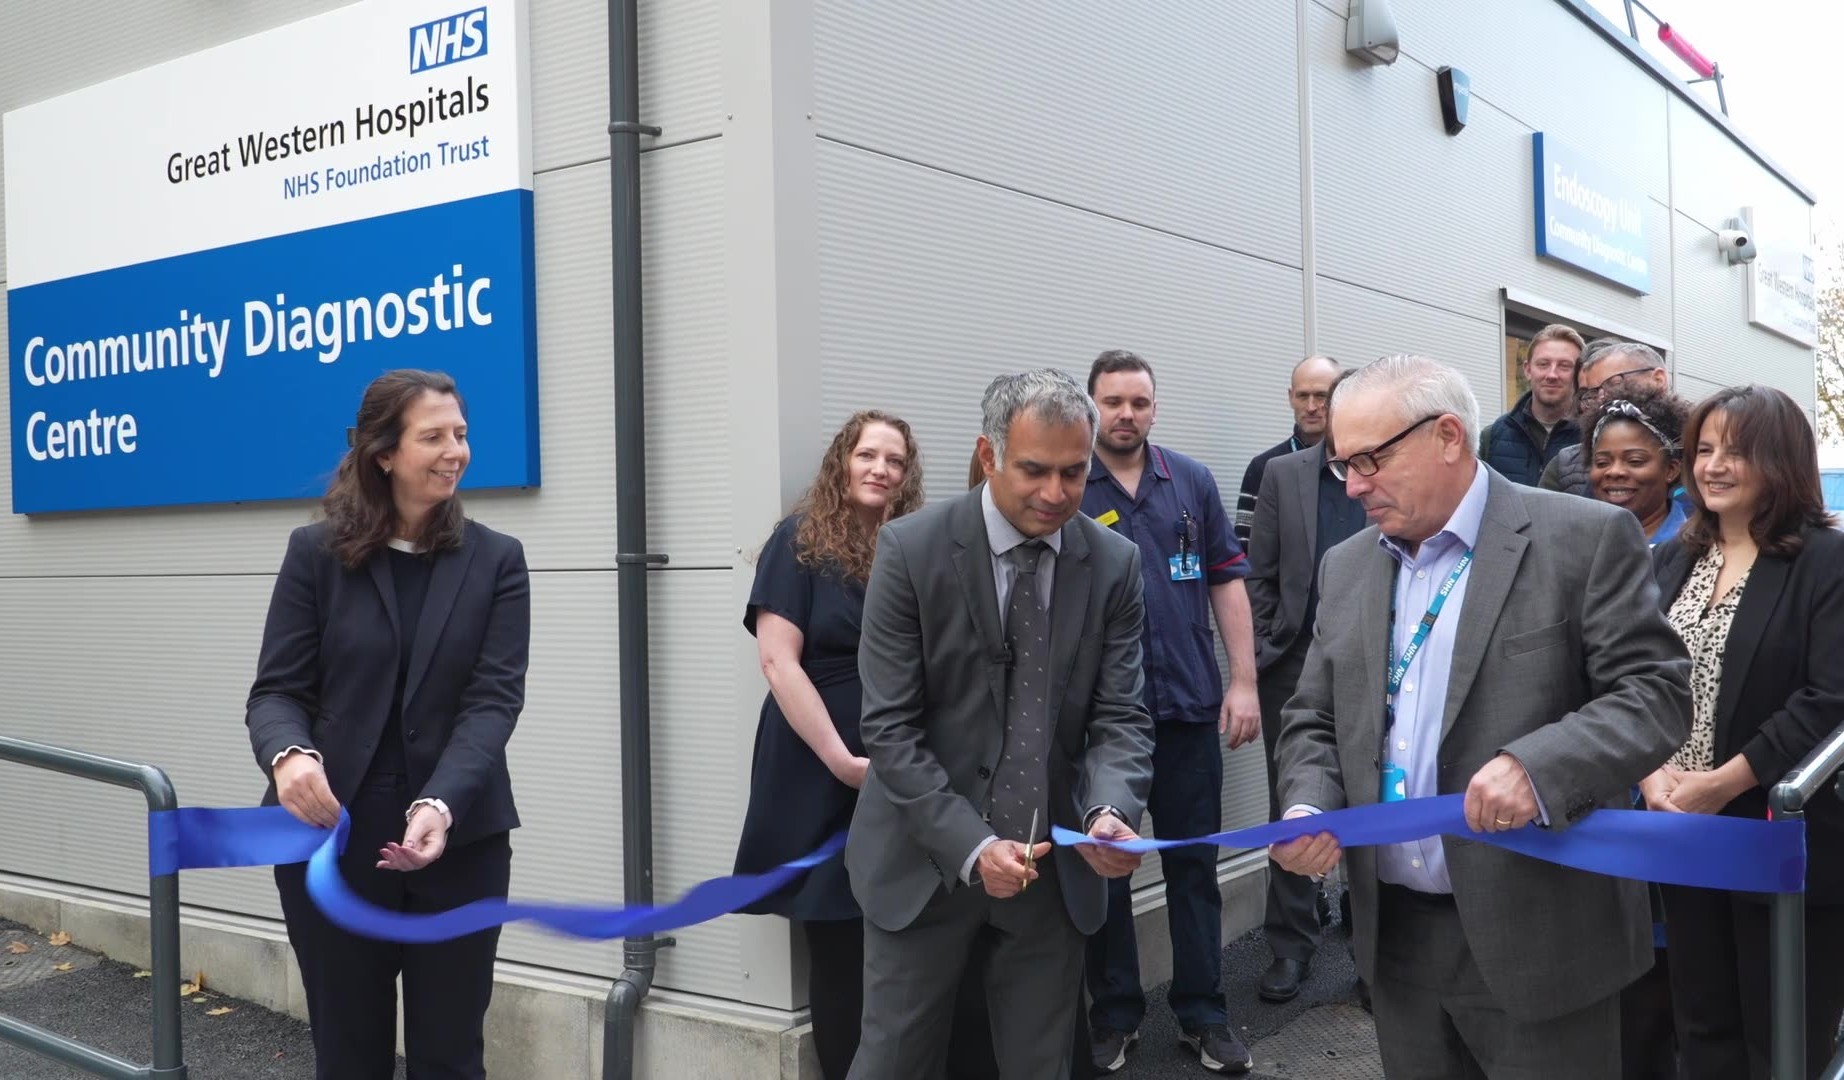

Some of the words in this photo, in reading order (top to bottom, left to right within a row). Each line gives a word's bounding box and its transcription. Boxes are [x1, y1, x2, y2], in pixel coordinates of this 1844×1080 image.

[412, 10, 486, 71] NHS
[168, 144, 231, 184] Great
[238, 118, 345, 168] Western
[356, 76, 490, 141] Hospitals
[284, 174, 320, 200] NHS
[326, 150, 431, 191] Foundation
[438, 135, 490, 165] Trust
[1554, 162, 1617, 232] Endoscopy
[1619, 196, 1642, 237] Unit
[24, 309, 231, 387] Community
[244, 263, 493, 365] Diagnostic
[26, 408, 138, 462] Centre
